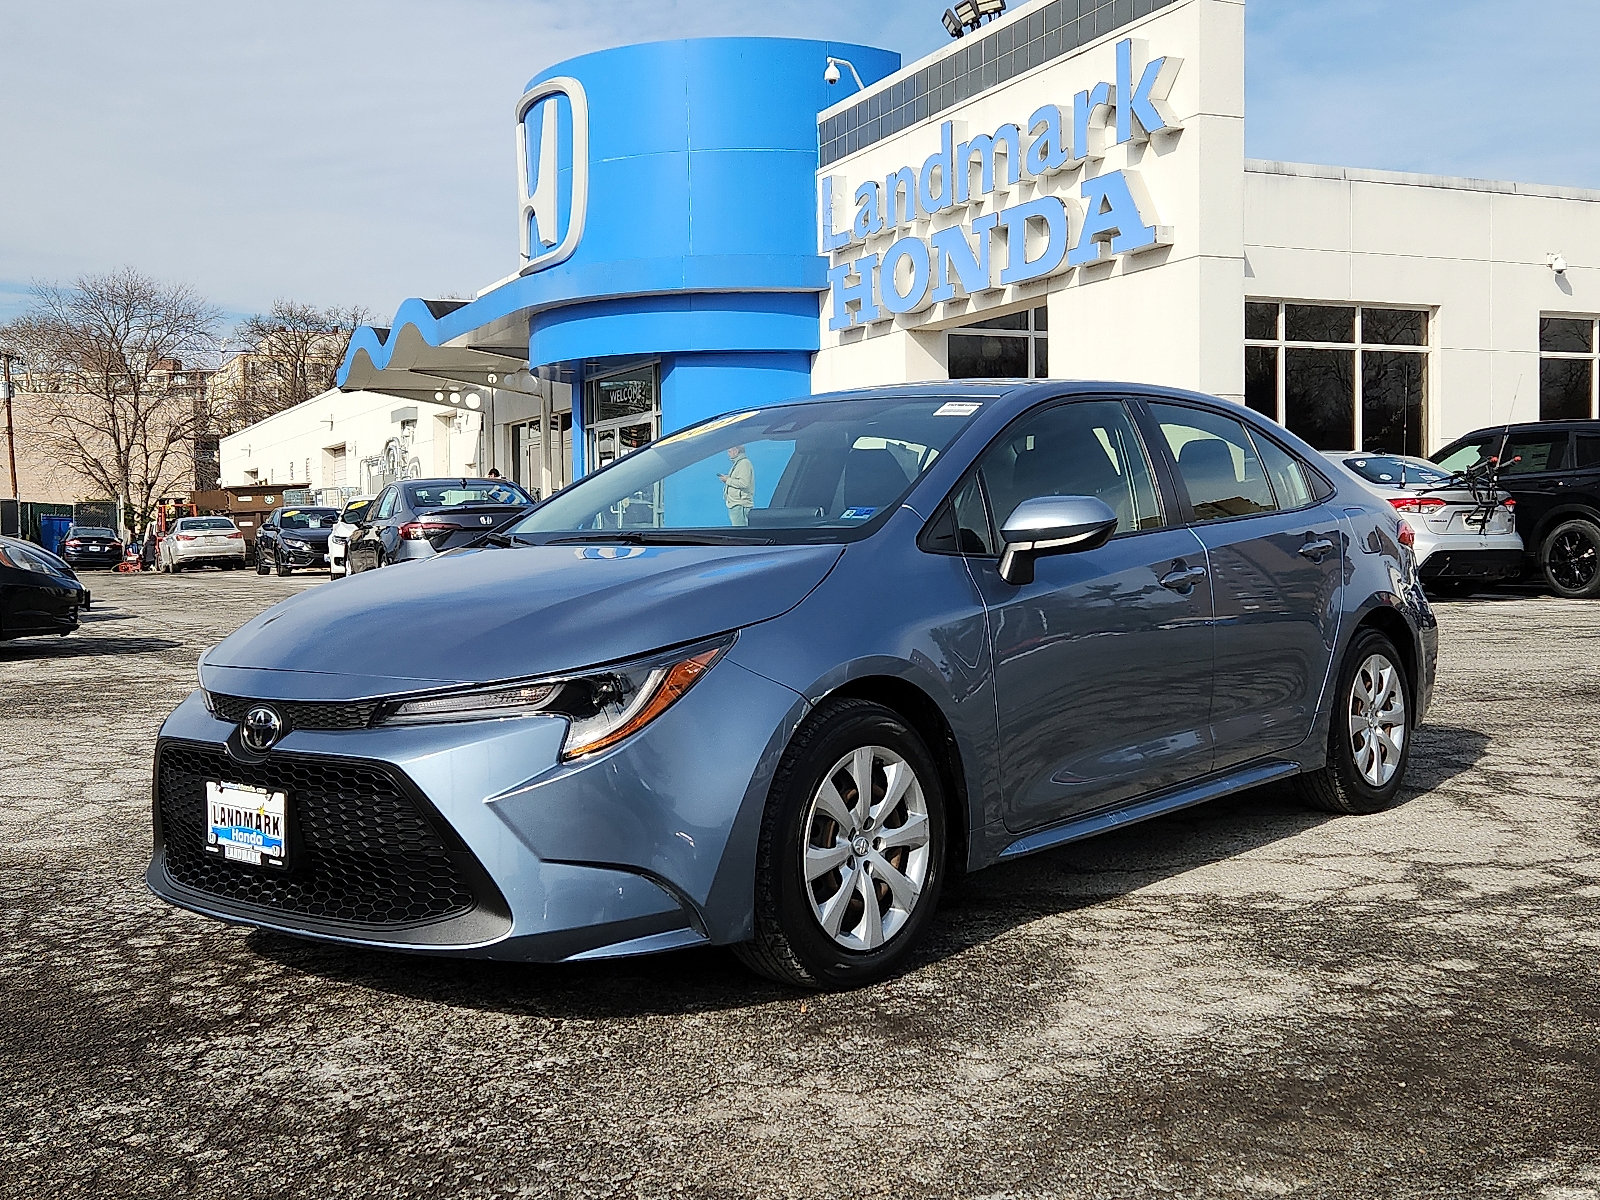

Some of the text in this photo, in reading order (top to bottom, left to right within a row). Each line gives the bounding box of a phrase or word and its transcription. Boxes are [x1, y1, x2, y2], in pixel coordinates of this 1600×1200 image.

[821, 38, 1183, 253] Landmark
[827, 169, 1166, 332] HONDA
[213, 804, 280, 837] LANDMARK
[231, 828, 264, 846] Honda
